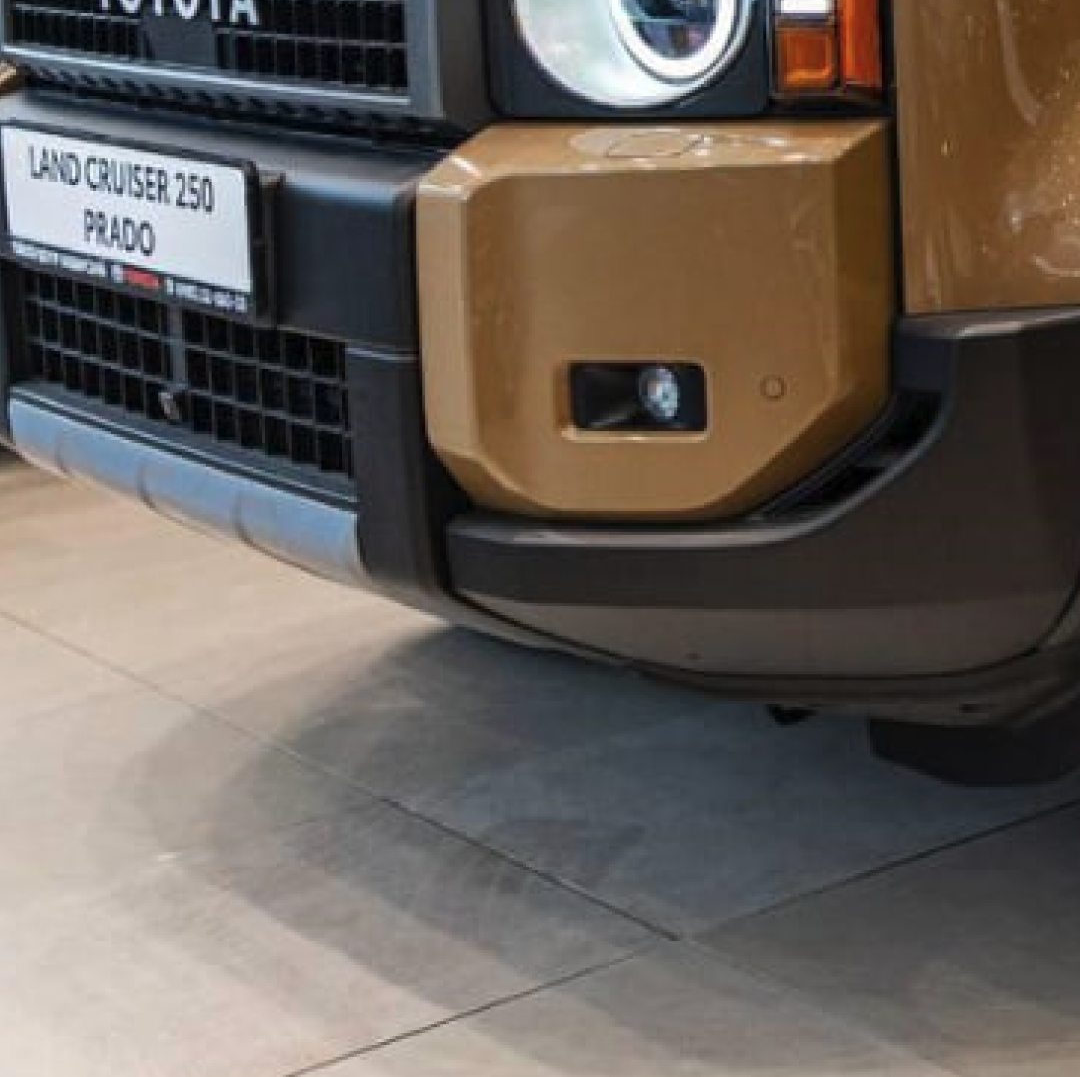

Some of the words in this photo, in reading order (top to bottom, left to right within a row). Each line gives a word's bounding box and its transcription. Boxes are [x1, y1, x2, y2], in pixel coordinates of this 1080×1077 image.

[29, 146, 81, 186] LAND
[85, 157, 171, 205] CRUISER
[175, 172, 214, 212] 250
[84, 208, 155, 256] PRADO
